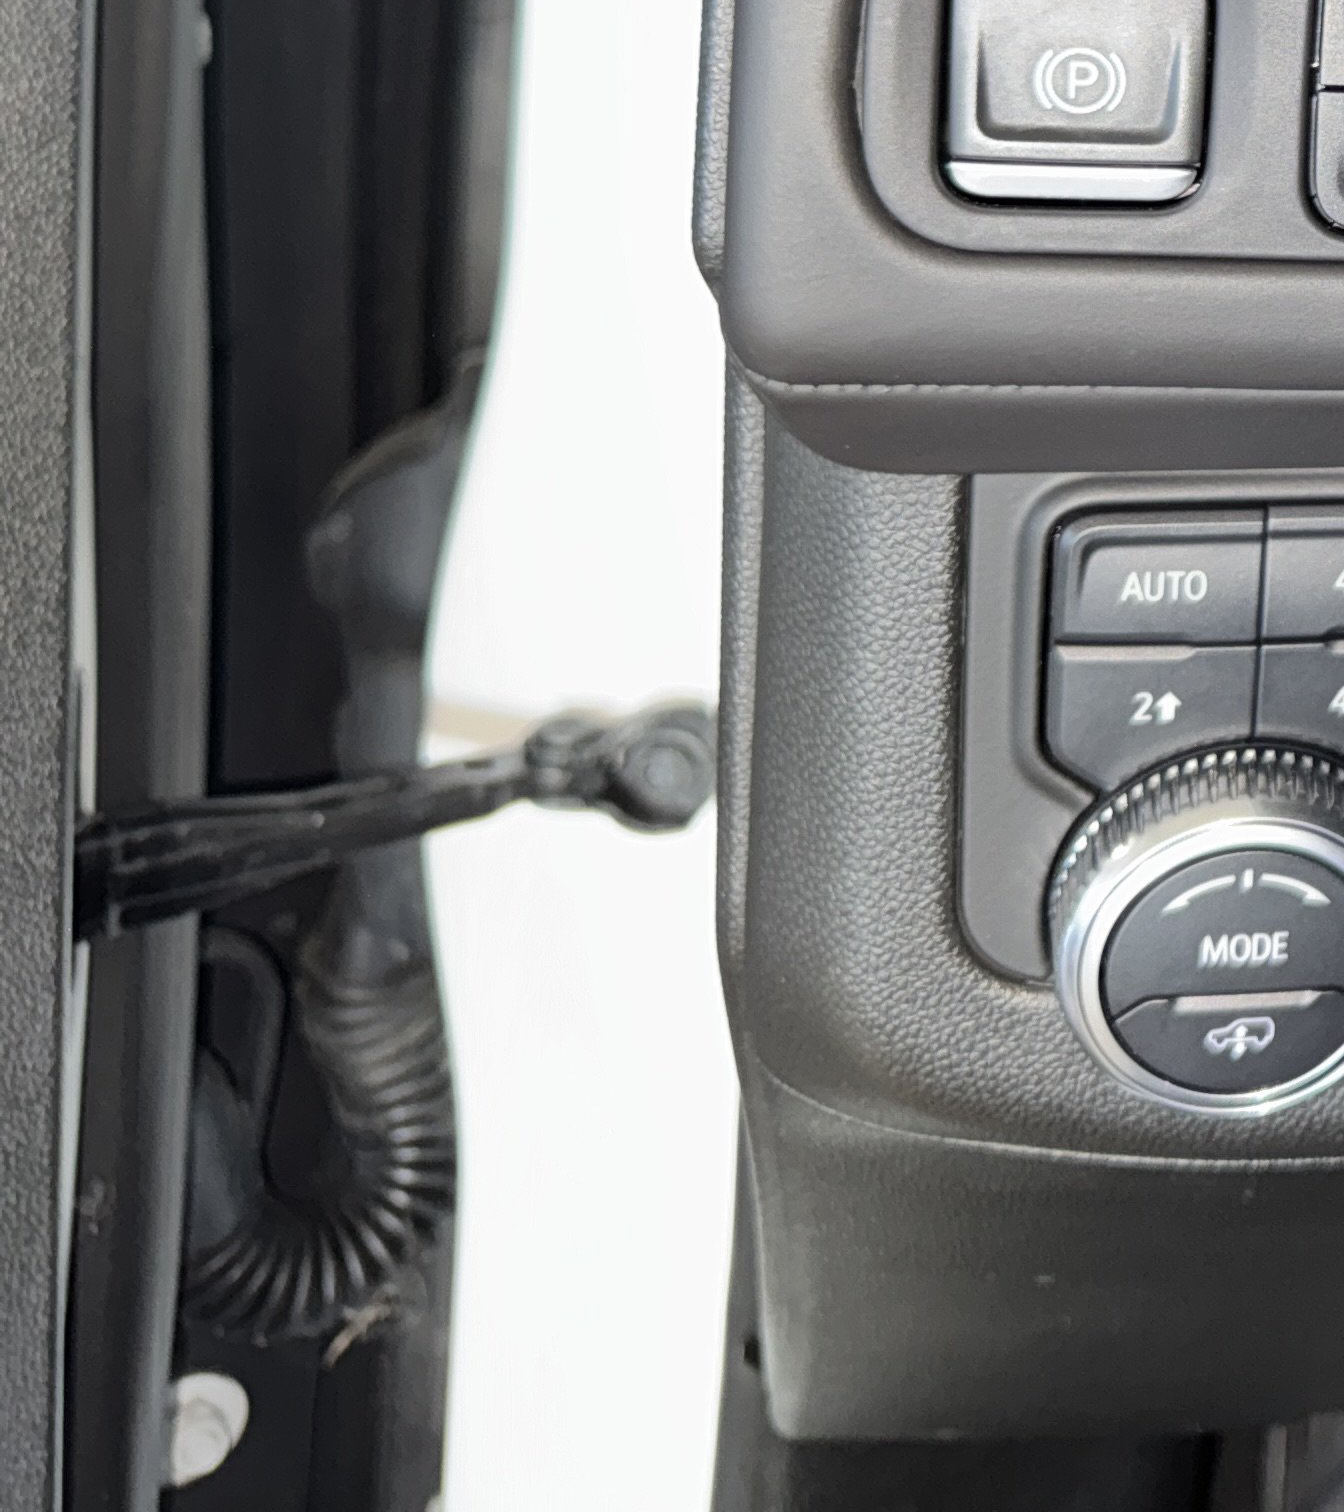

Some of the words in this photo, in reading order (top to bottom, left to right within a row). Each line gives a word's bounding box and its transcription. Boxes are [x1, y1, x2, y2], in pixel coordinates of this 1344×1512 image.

[1120, 569, 1208, 604] AUTO
[1129, 691, 1155, 726] 2
[1198, 930, 1290, 968] MODE
